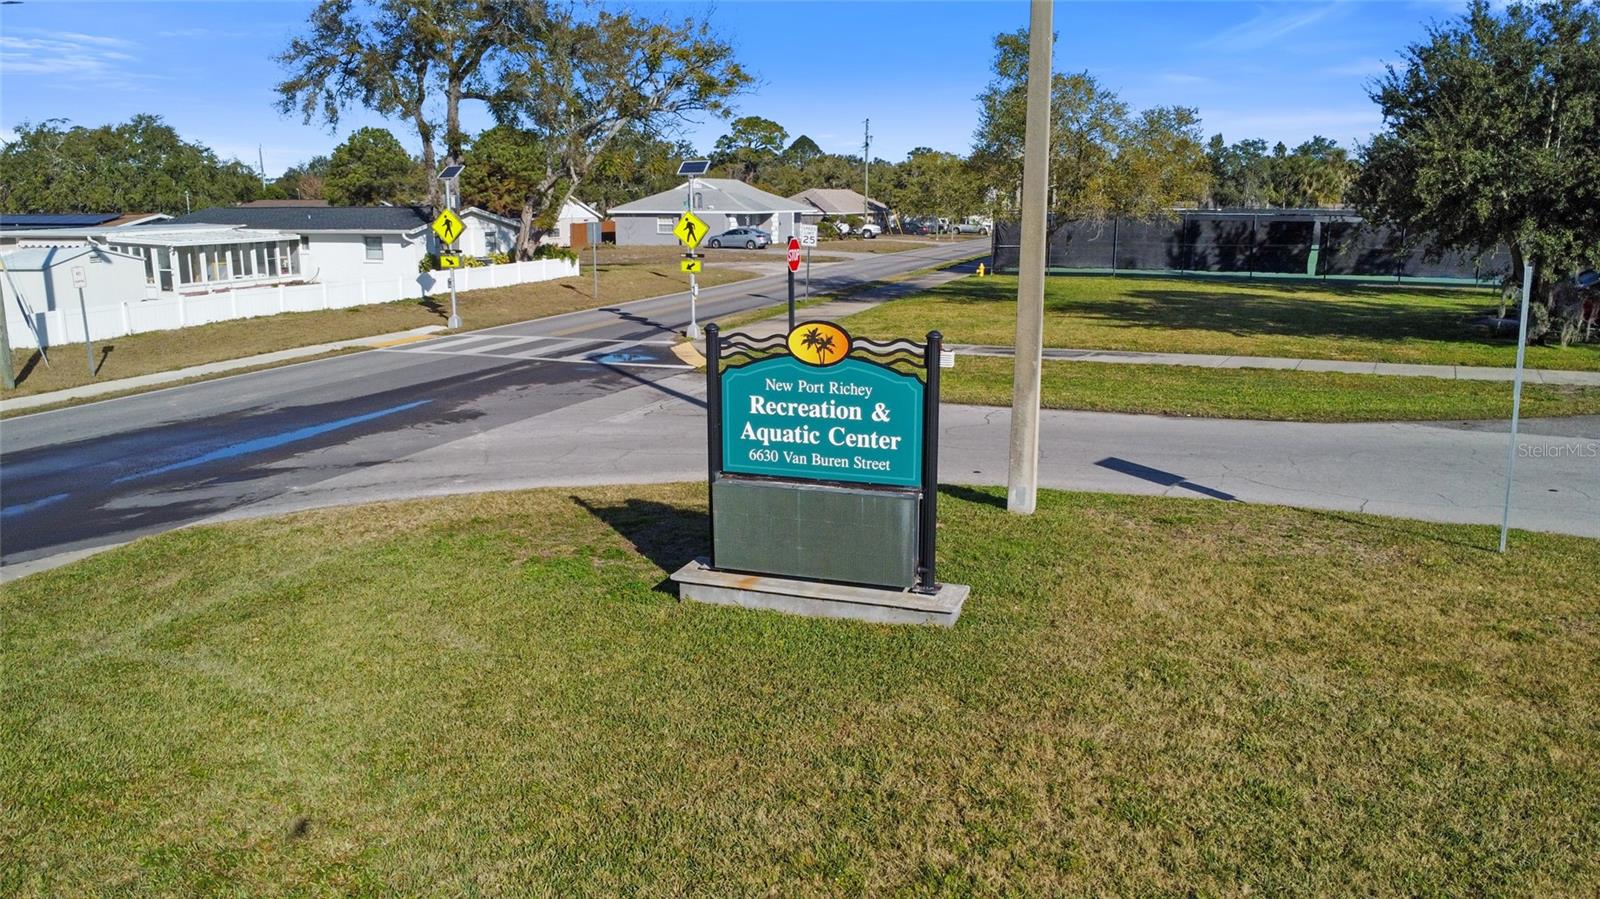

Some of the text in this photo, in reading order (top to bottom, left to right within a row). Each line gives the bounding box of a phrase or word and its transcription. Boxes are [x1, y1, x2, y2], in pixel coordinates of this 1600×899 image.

[803, 235, 815, 244] 25
[788, 249, 800, 261] STOP
[765, 378, 872, 399] New Port Richey
[750, 395, 891, 422] Recreation &
[741, 421, 901, 450] Aquatic Center
[749, 449, 890, 470] 6630 Van Buren Street
